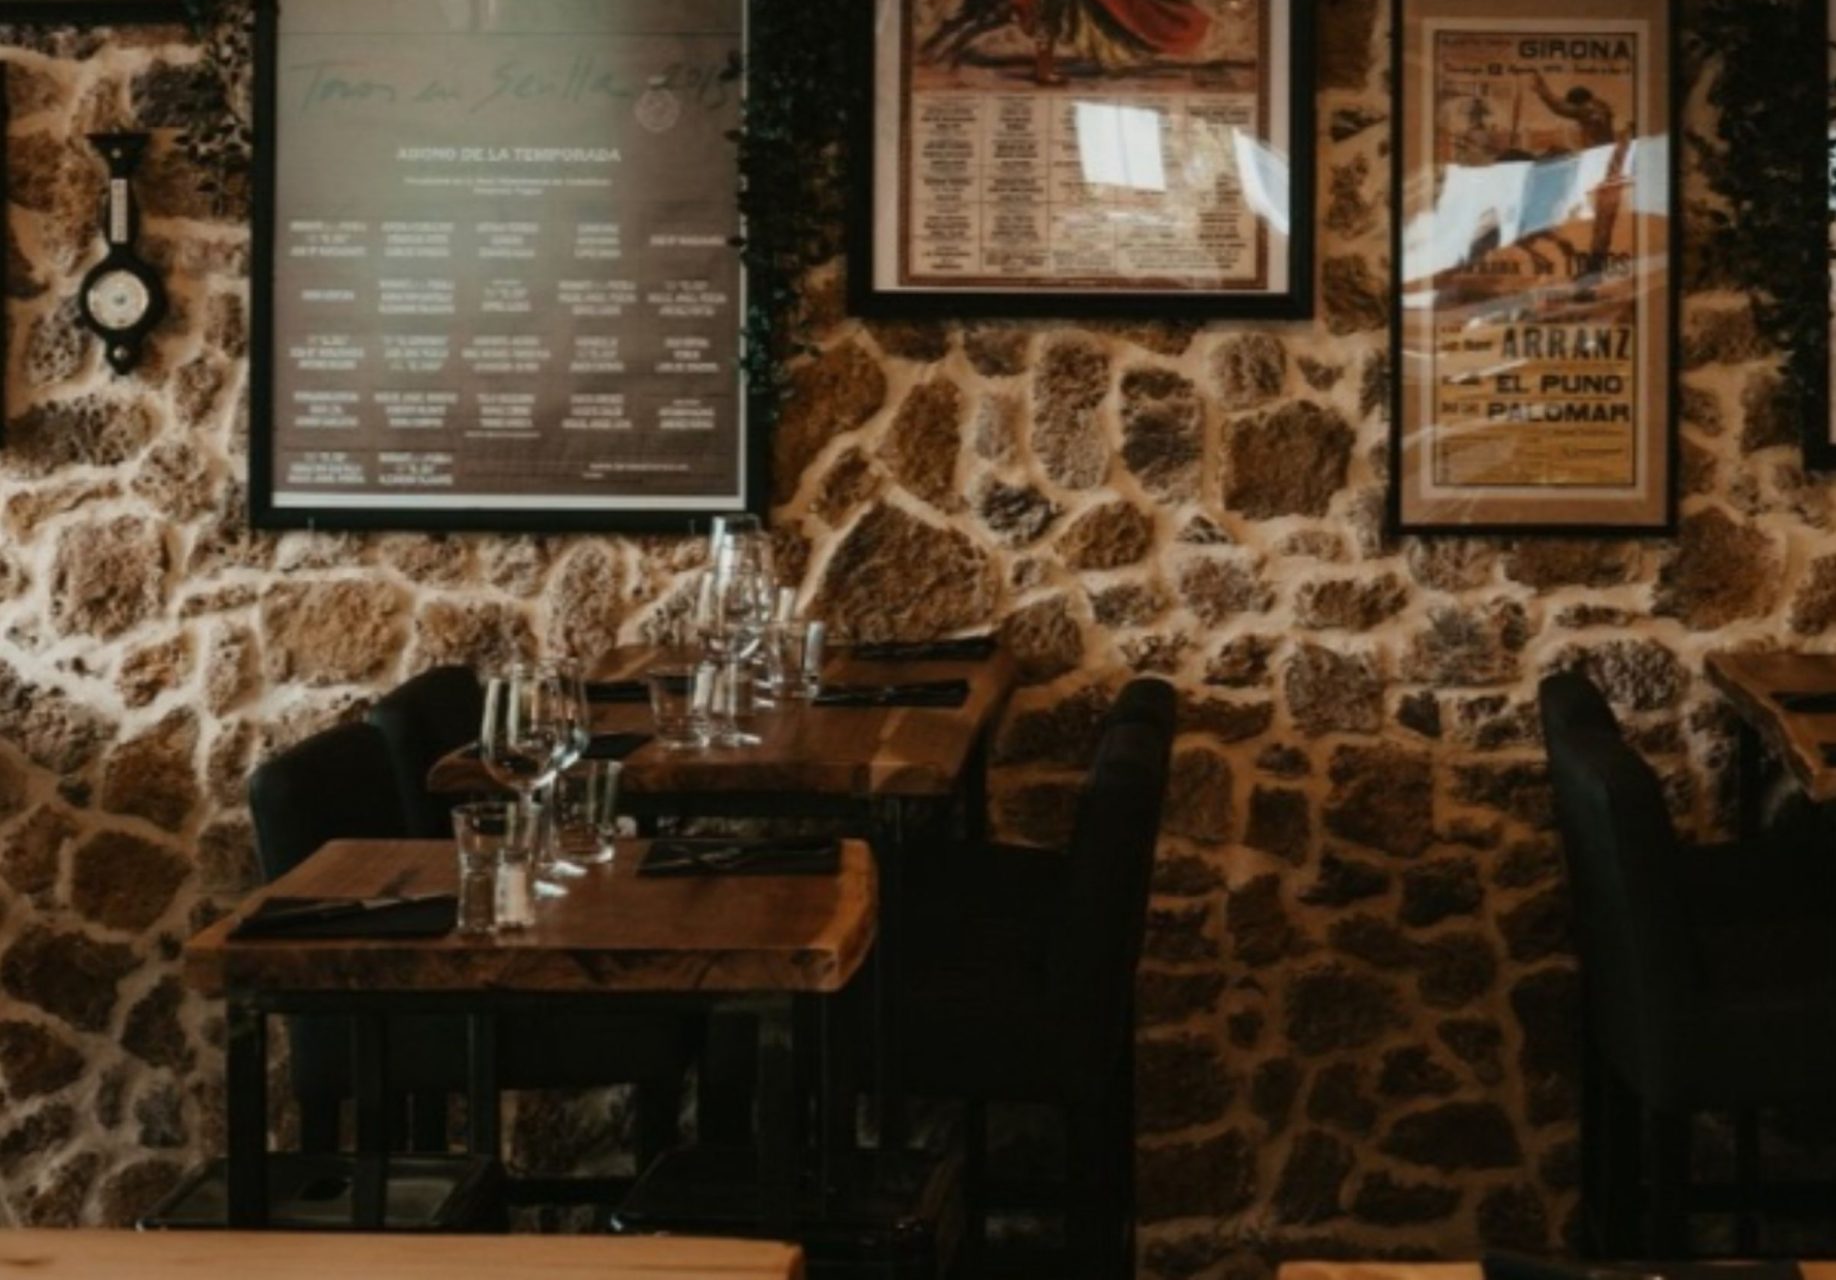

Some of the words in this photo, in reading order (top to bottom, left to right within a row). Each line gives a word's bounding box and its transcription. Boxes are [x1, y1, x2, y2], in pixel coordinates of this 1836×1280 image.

[1518, 39, 1630, 60] GIRONA
[514, 147, 622, 163] TEMPORADA
[1502, 326, 1631, 361] ARRANZ
[1497, 373, 1530, 394] EL
[1487, 402, 1631, 423] PALOMAR
